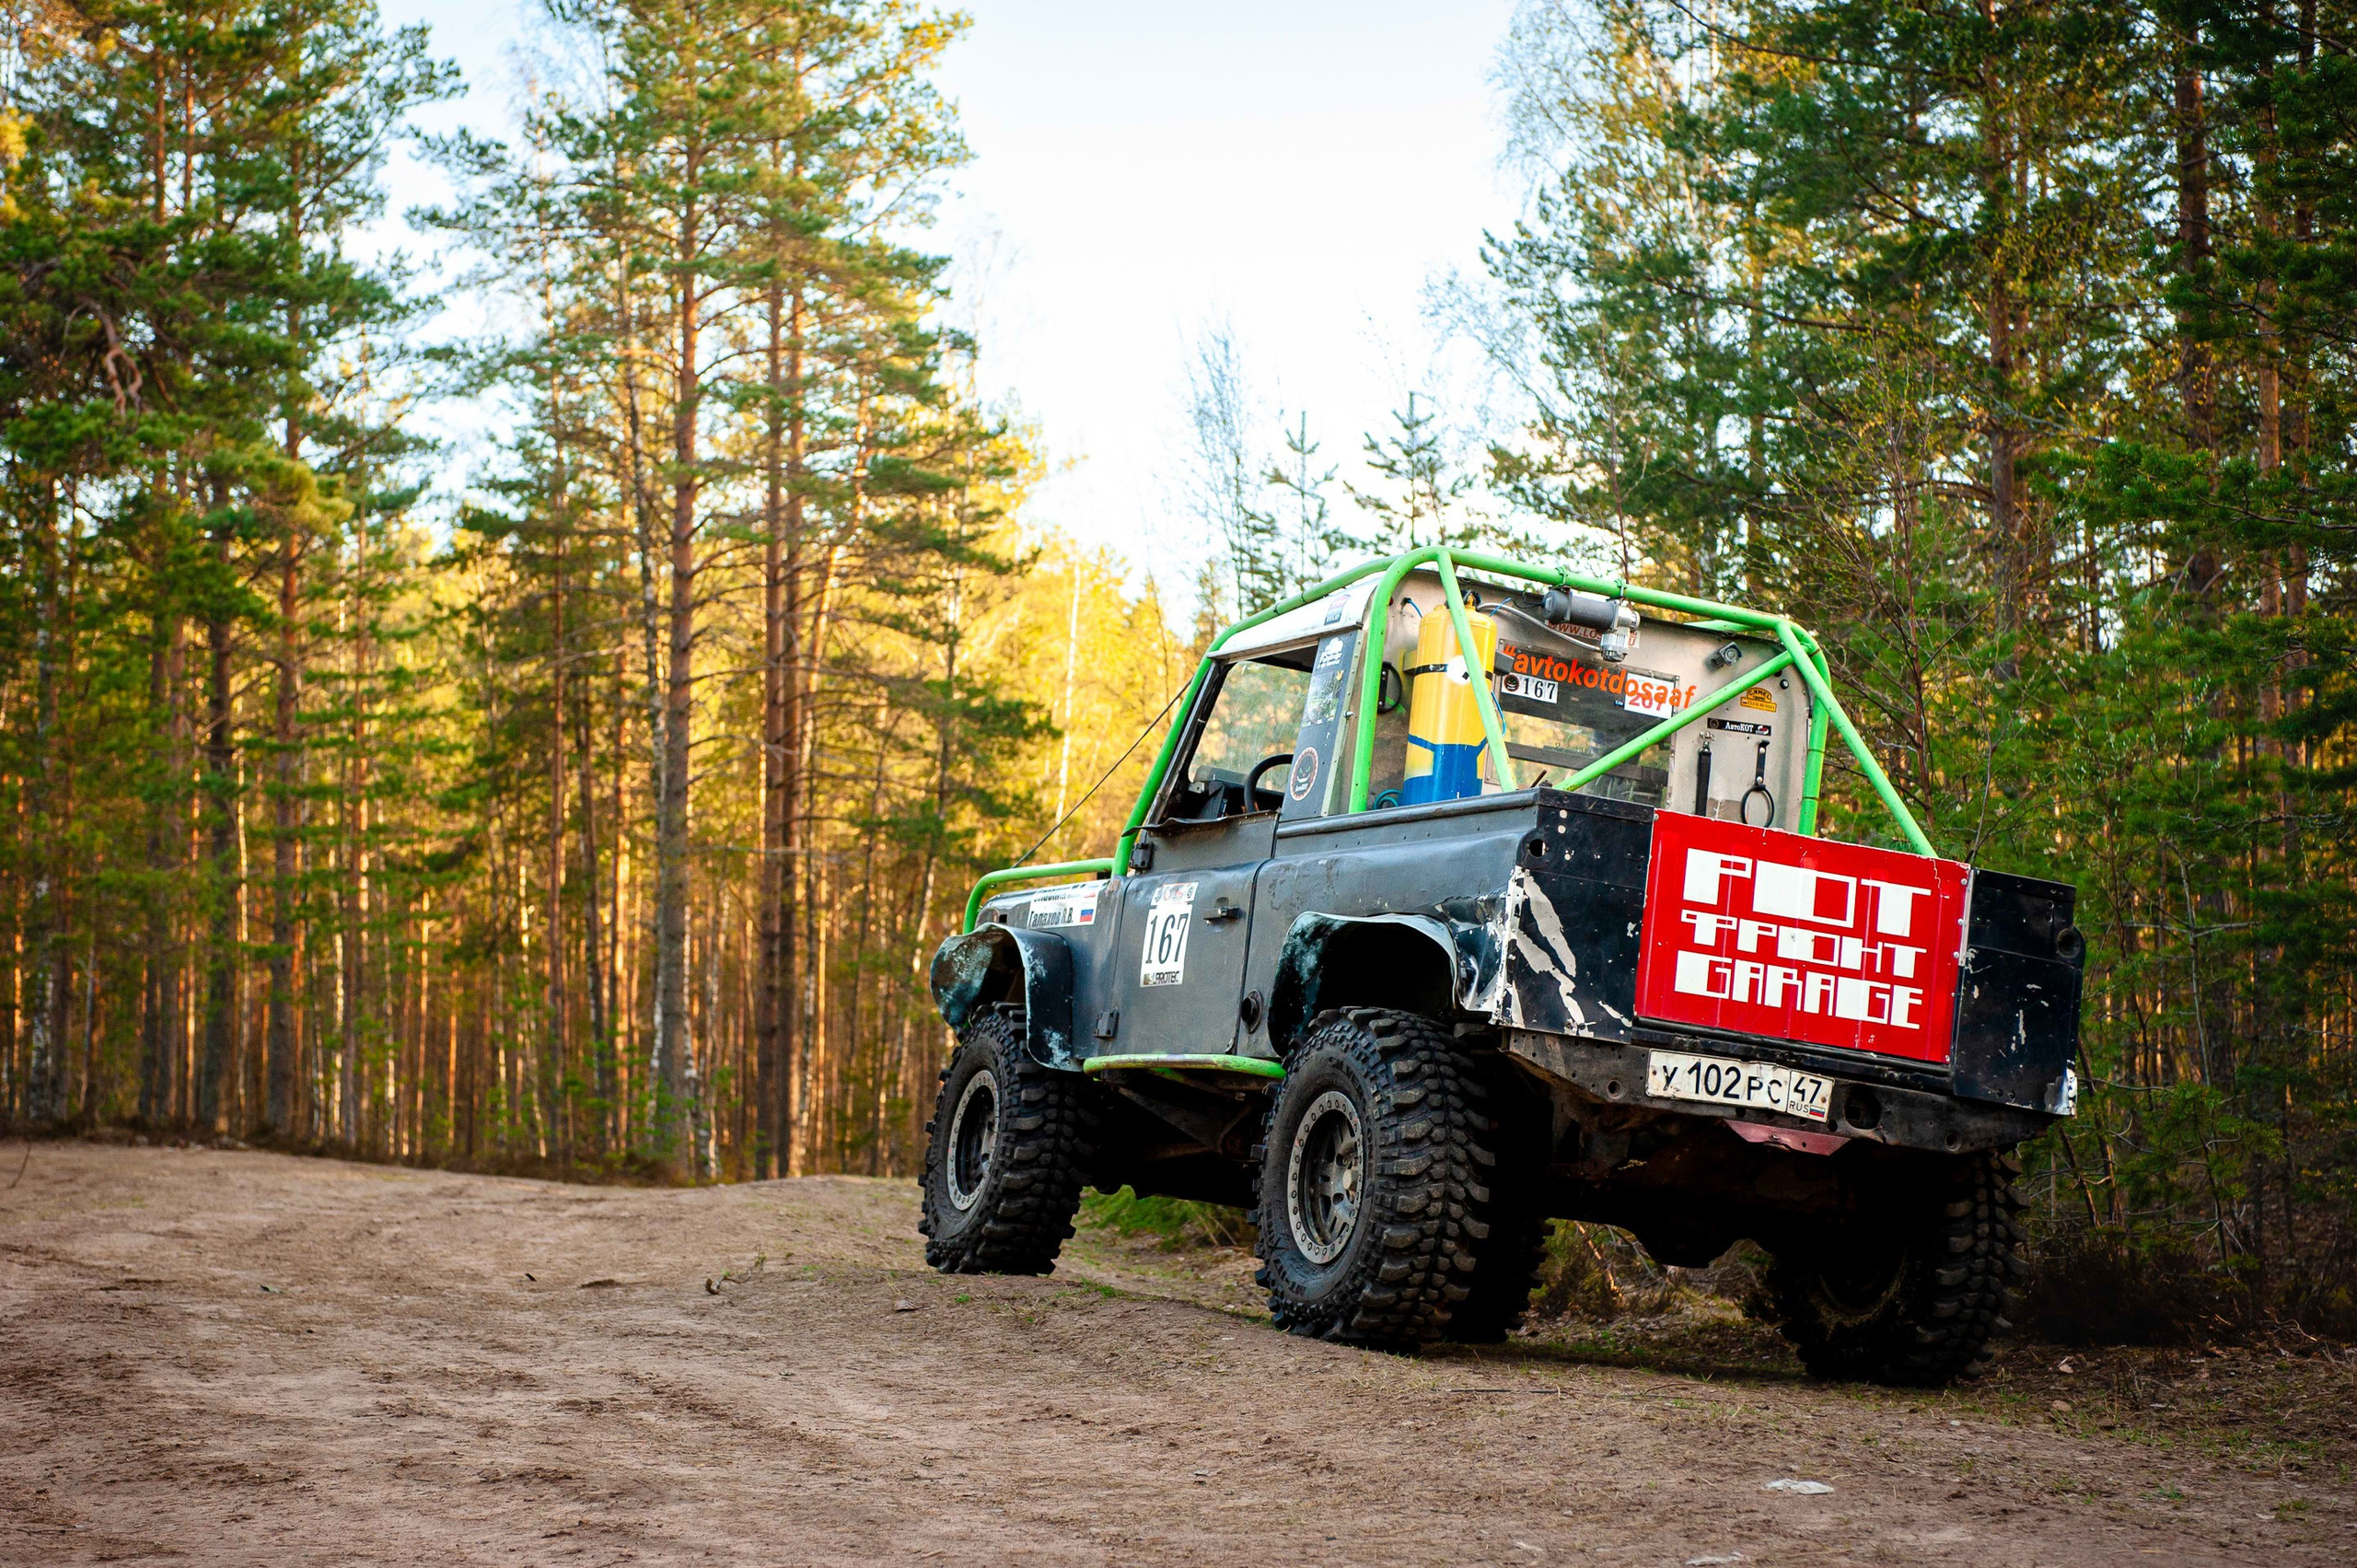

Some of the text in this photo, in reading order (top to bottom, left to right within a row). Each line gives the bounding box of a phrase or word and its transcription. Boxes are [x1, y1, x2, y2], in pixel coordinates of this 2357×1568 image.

[1524, 677, 1556, 700] 167
[1748, 690, 1771, 700] CAMEL
[1028, 911, 1061, 927] Галахов
[1145, 912, 1190, 965] 167
[1680, 909, 1927, 979] ФРОНТ
[1674, 950, 1924, 1030] GARAGE
[1794, 1076, 1822, 1105] 47
[1789, 1100, 1809, 1114] RUS
